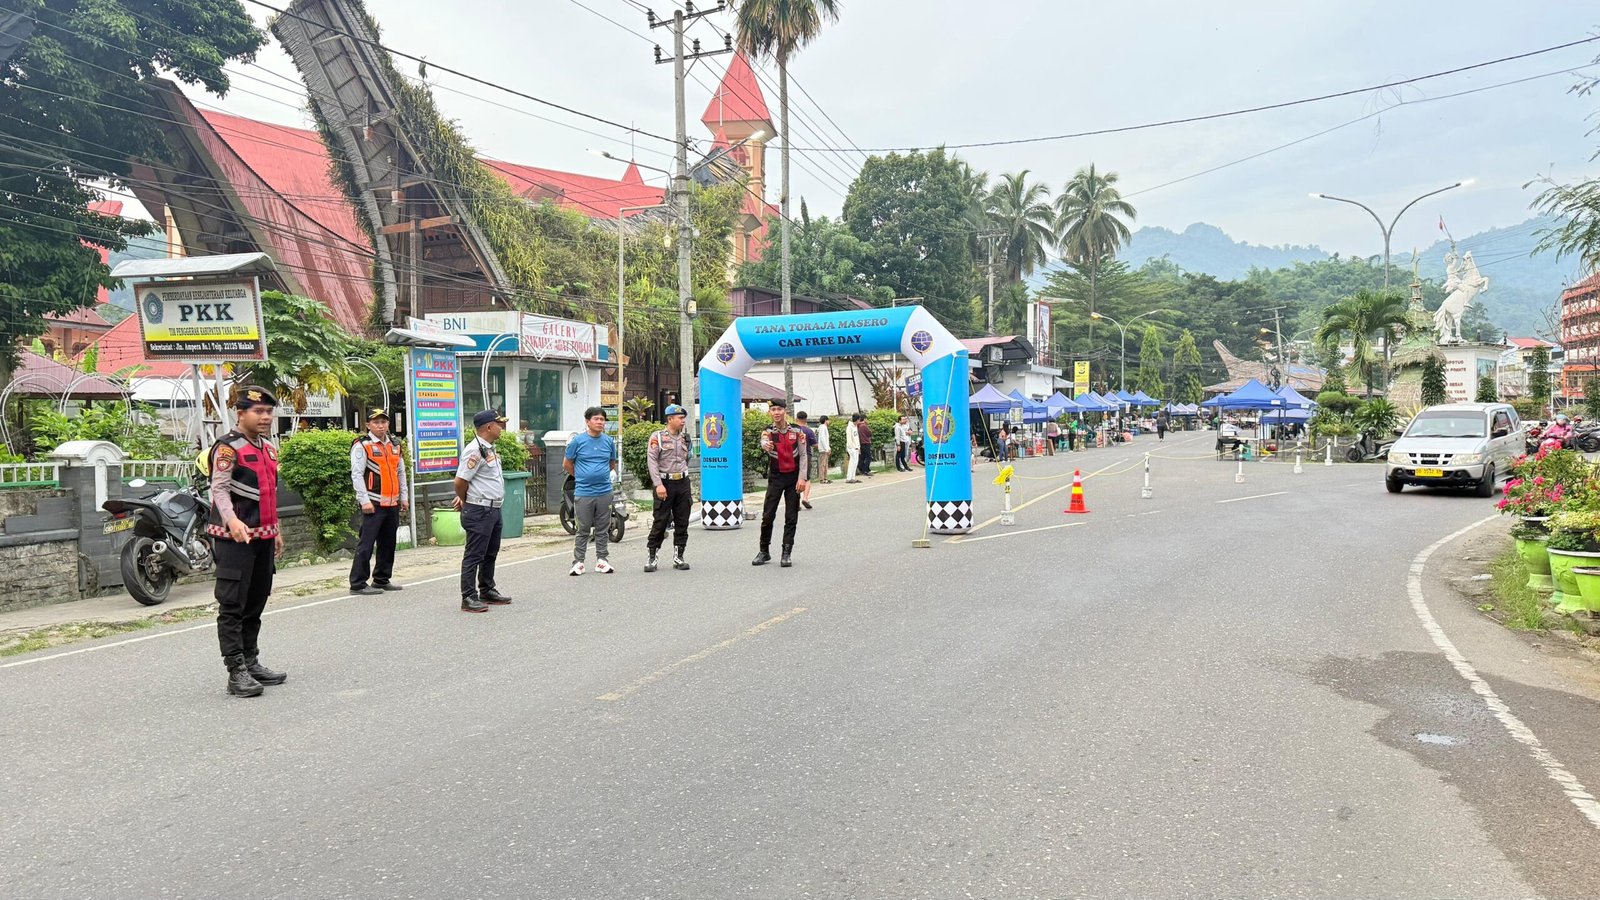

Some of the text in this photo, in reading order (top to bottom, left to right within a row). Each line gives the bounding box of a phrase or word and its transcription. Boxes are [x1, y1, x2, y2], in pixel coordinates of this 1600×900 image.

[178, 304, 233, 321] PKK
[444, 318, 466, 330] BNI
[543, 323, 576, 338] GALERY
[755, 318, 888, 334] TANA TORAJA MASERO
[184, 344, 201, 352] Ampera
[779, 335, 862, 348] CAR FREE DAY
[424, 353, 432, 369] 10
[434, 361, 454, 370] PKK
